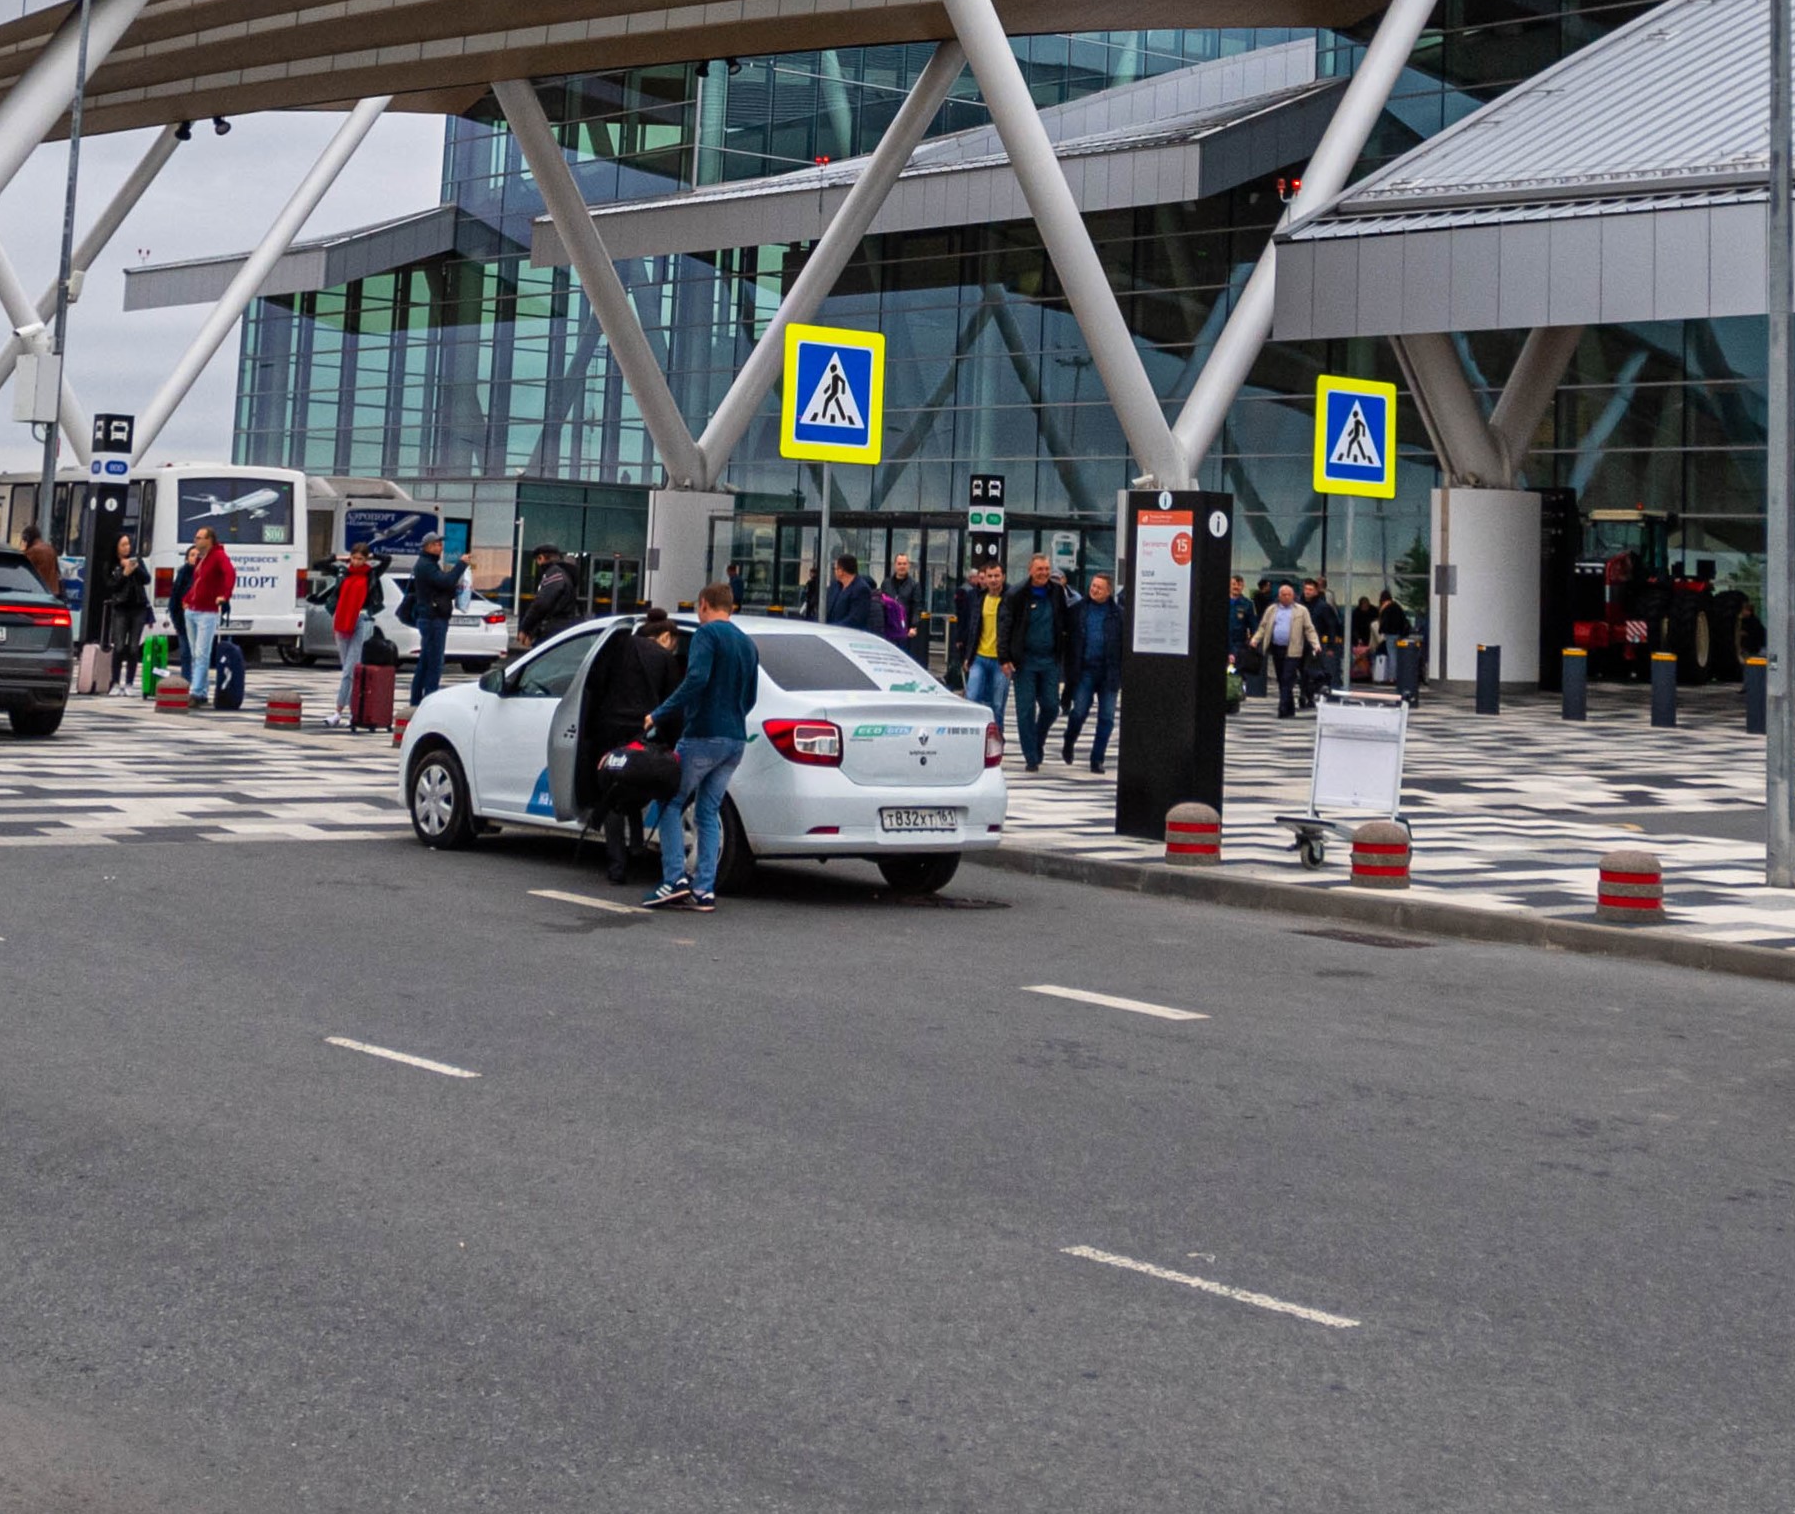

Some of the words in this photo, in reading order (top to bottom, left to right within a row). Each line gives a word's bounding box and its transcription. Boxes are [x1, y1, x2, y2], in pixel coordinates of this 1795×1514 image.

[1176, 539, 1188, 552] 15
[230, 555, 278, 565] черкасск
[237, 576, 278, 588] ПОРТ
